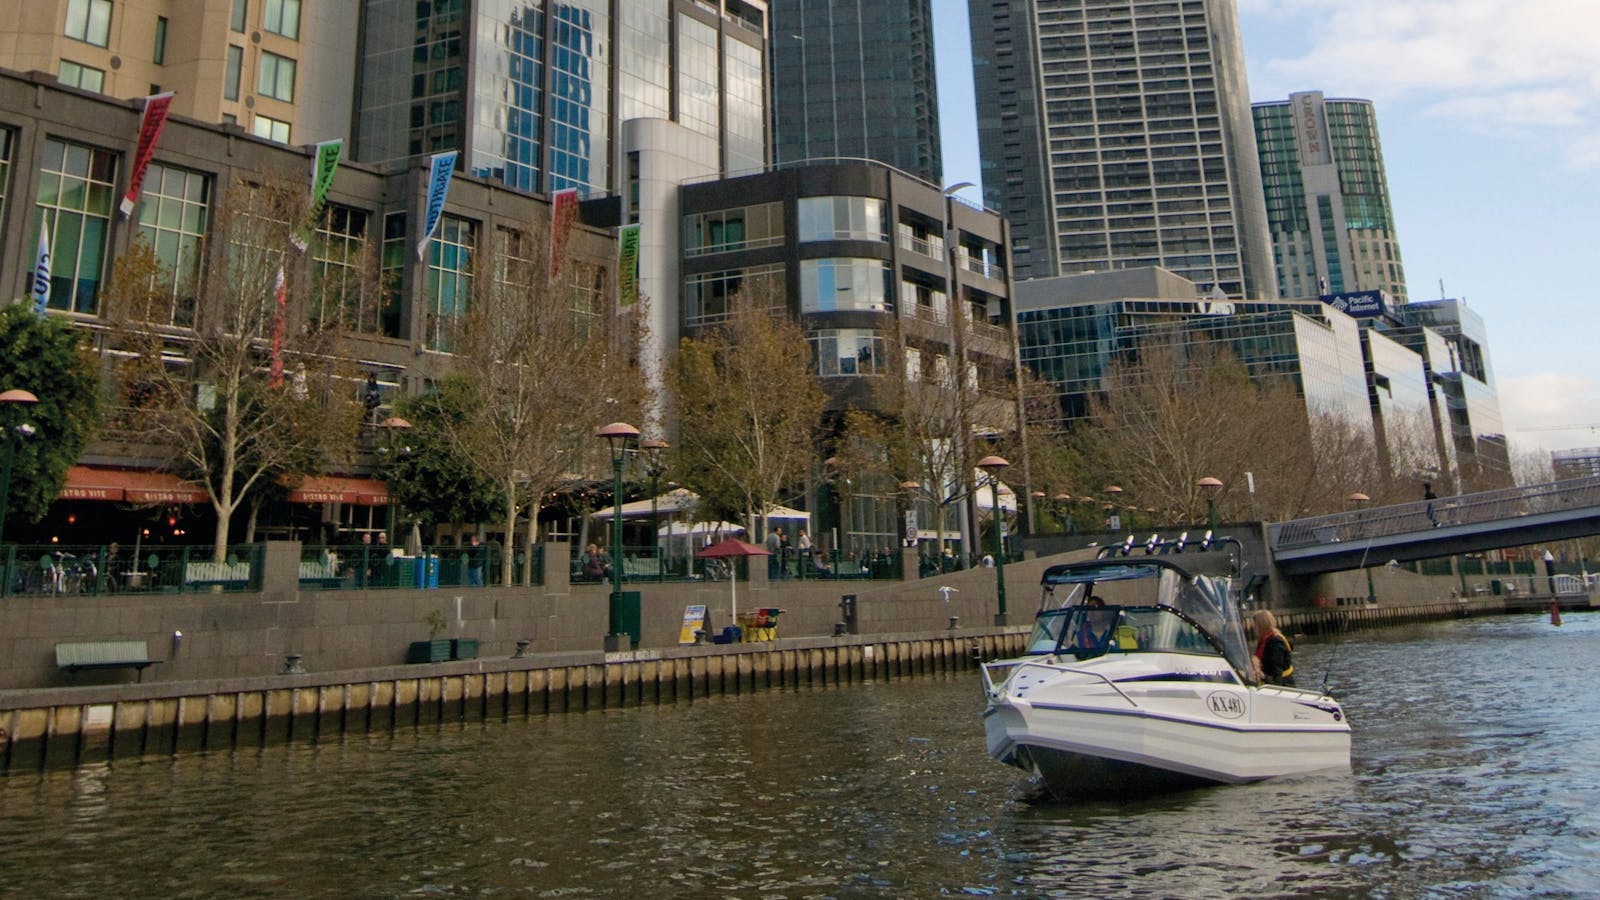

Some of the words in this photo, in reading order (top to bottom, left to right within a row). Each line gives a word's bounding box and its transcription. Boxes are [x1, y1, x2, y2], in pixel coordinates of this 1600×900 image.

[1348, 295, 1374, 304] Pacific
[1350, 302, 1380, 312] Internet
[145, 492, 173, 501] BISTRO
[303, 493, 328, 501] BISTRO
